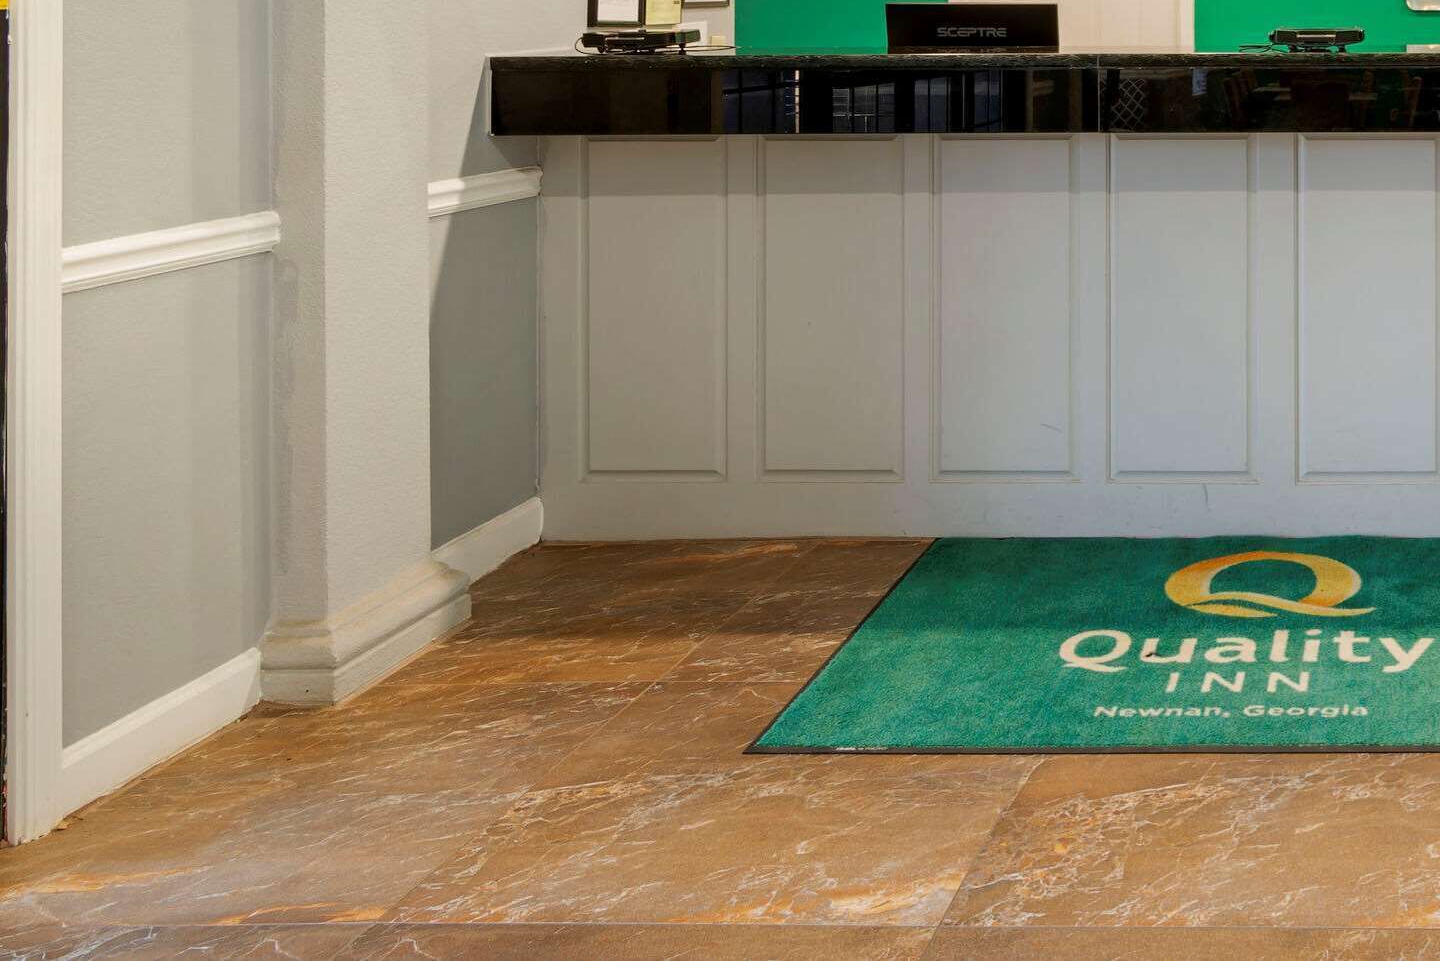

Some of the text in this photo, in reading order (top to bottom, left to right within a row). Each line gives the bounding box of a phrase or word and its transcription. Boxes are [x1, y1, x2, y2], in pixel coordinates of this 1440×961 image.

[937, 27, 1007, 38] SCEPTRE
[1058, 629, 1435, 673] Quality
[1165, 671, 1312, 694] INN
[1243, 704, 1370, 718] Georgia
